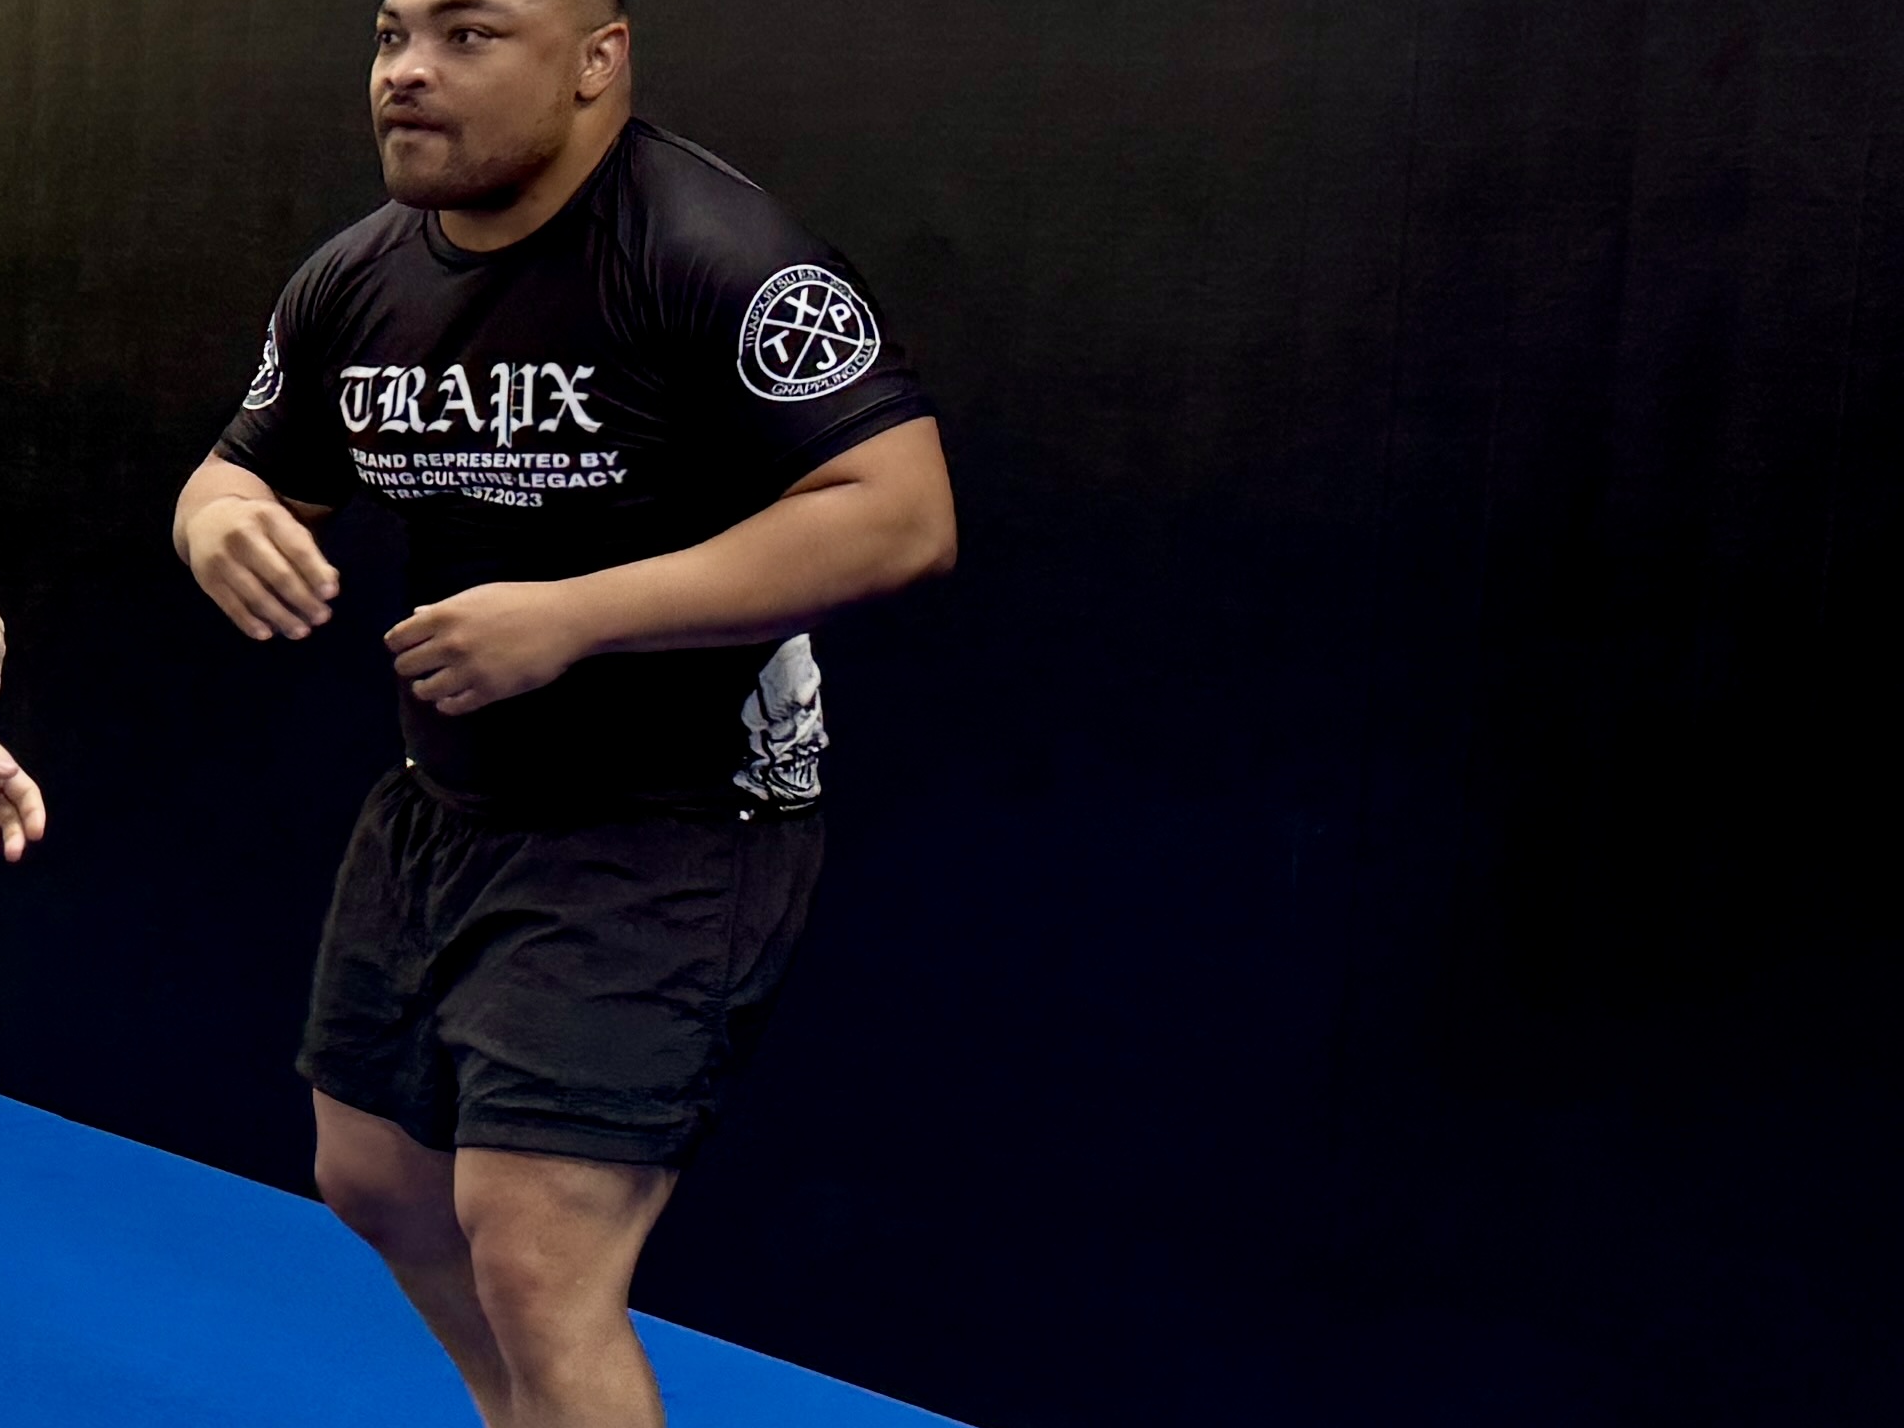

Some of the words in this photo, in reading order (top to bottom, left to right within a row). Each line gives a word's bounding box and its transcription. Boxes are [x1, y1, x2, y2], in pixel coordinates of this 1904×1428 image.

[339, 362, 604, 449] TRAPX
[413, 452, 571, 469] REPRESENTED
[580, 450, 620, 469] BY
